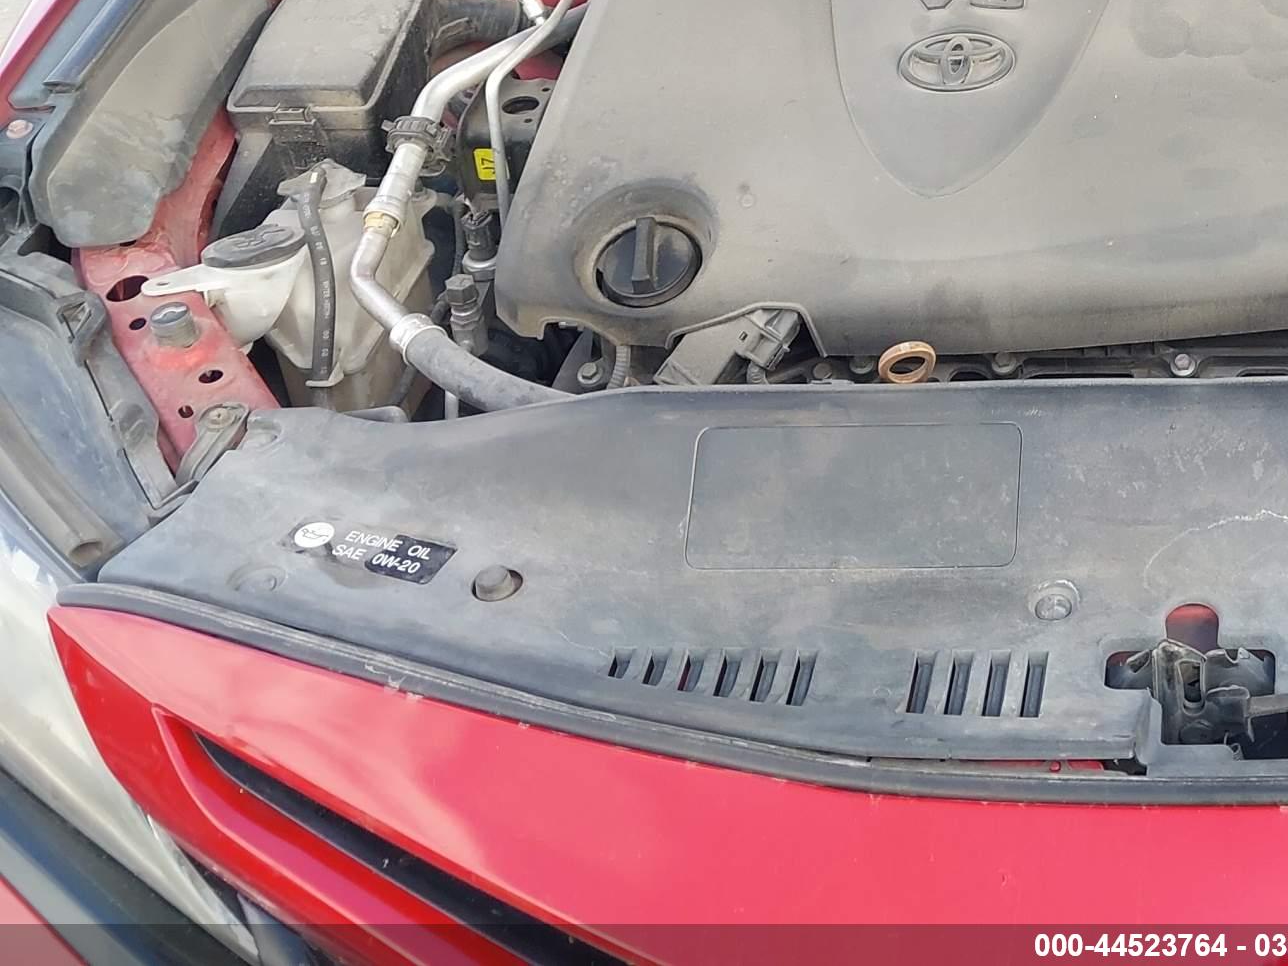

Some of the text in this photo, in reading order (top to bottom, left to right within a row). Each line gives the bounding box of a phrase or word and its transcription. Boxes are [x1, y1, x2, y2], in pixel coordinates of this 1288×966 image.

[331, 544, 422, 575] SAE 0W-20
[344, 530, 432, 560] ENGINE OIL
